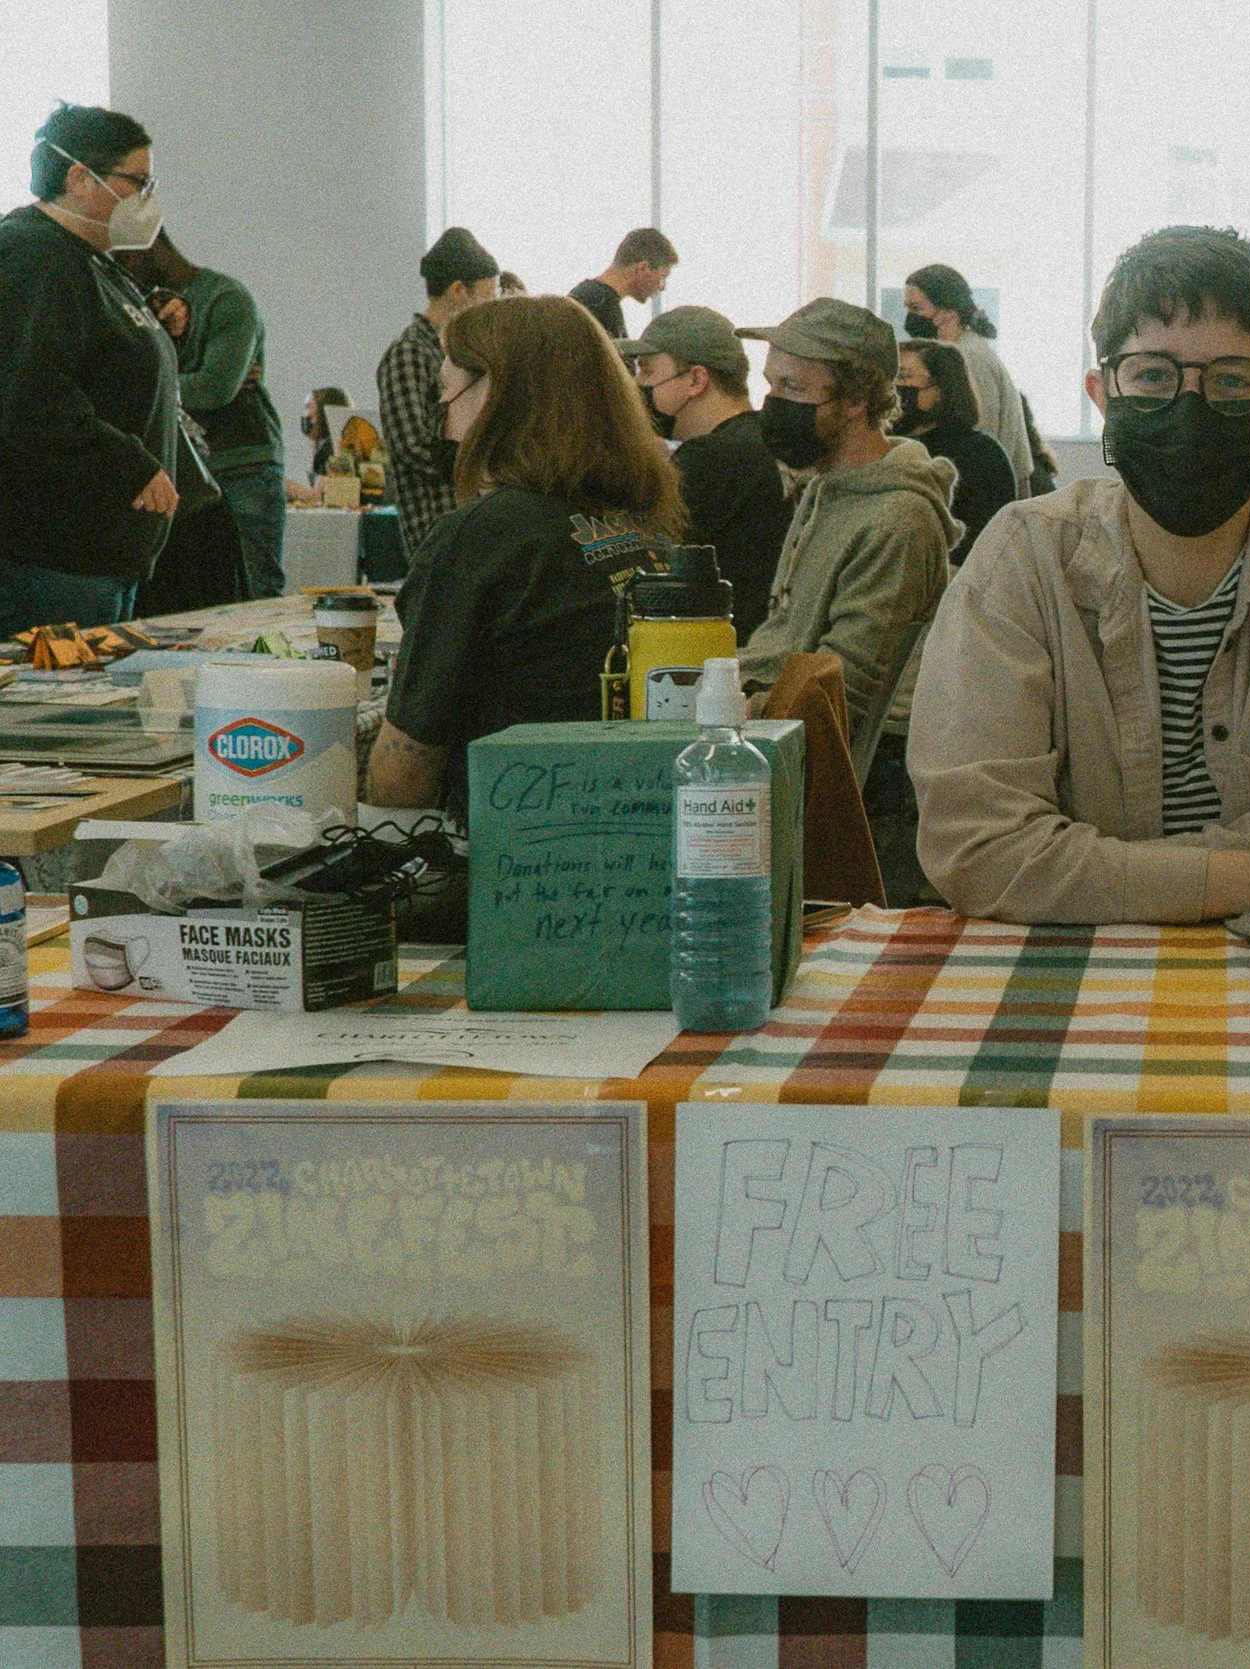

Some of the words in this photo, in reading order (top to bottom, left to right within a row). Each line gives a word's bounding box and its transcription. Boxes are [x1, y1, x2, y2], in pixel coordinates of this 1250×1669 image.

[216, 734, 292, 760] CLOROX
[684, 800, 717, 813] Hand
[721, 799, 744, 813] Aid
[497, 852, 592, 881] Donations
[602, 852, 636, 872] will
[179, 924, 219, 947] FACE
[226, 926, 292, 948] MASKS
[535, 902, 604, 941] next
[619, 911, 674, 950] yea
[182, 947, 231, 965] MASQUE
[235, 950, 292, 967] FACIAUX
[206, 1160, 292, 1194] 2022
[1139, 1173, 1224, 1209] 2022
[714, 1138, 1004, 1288] FREE
[685, 1288, 1028, 1428] ENTRY
